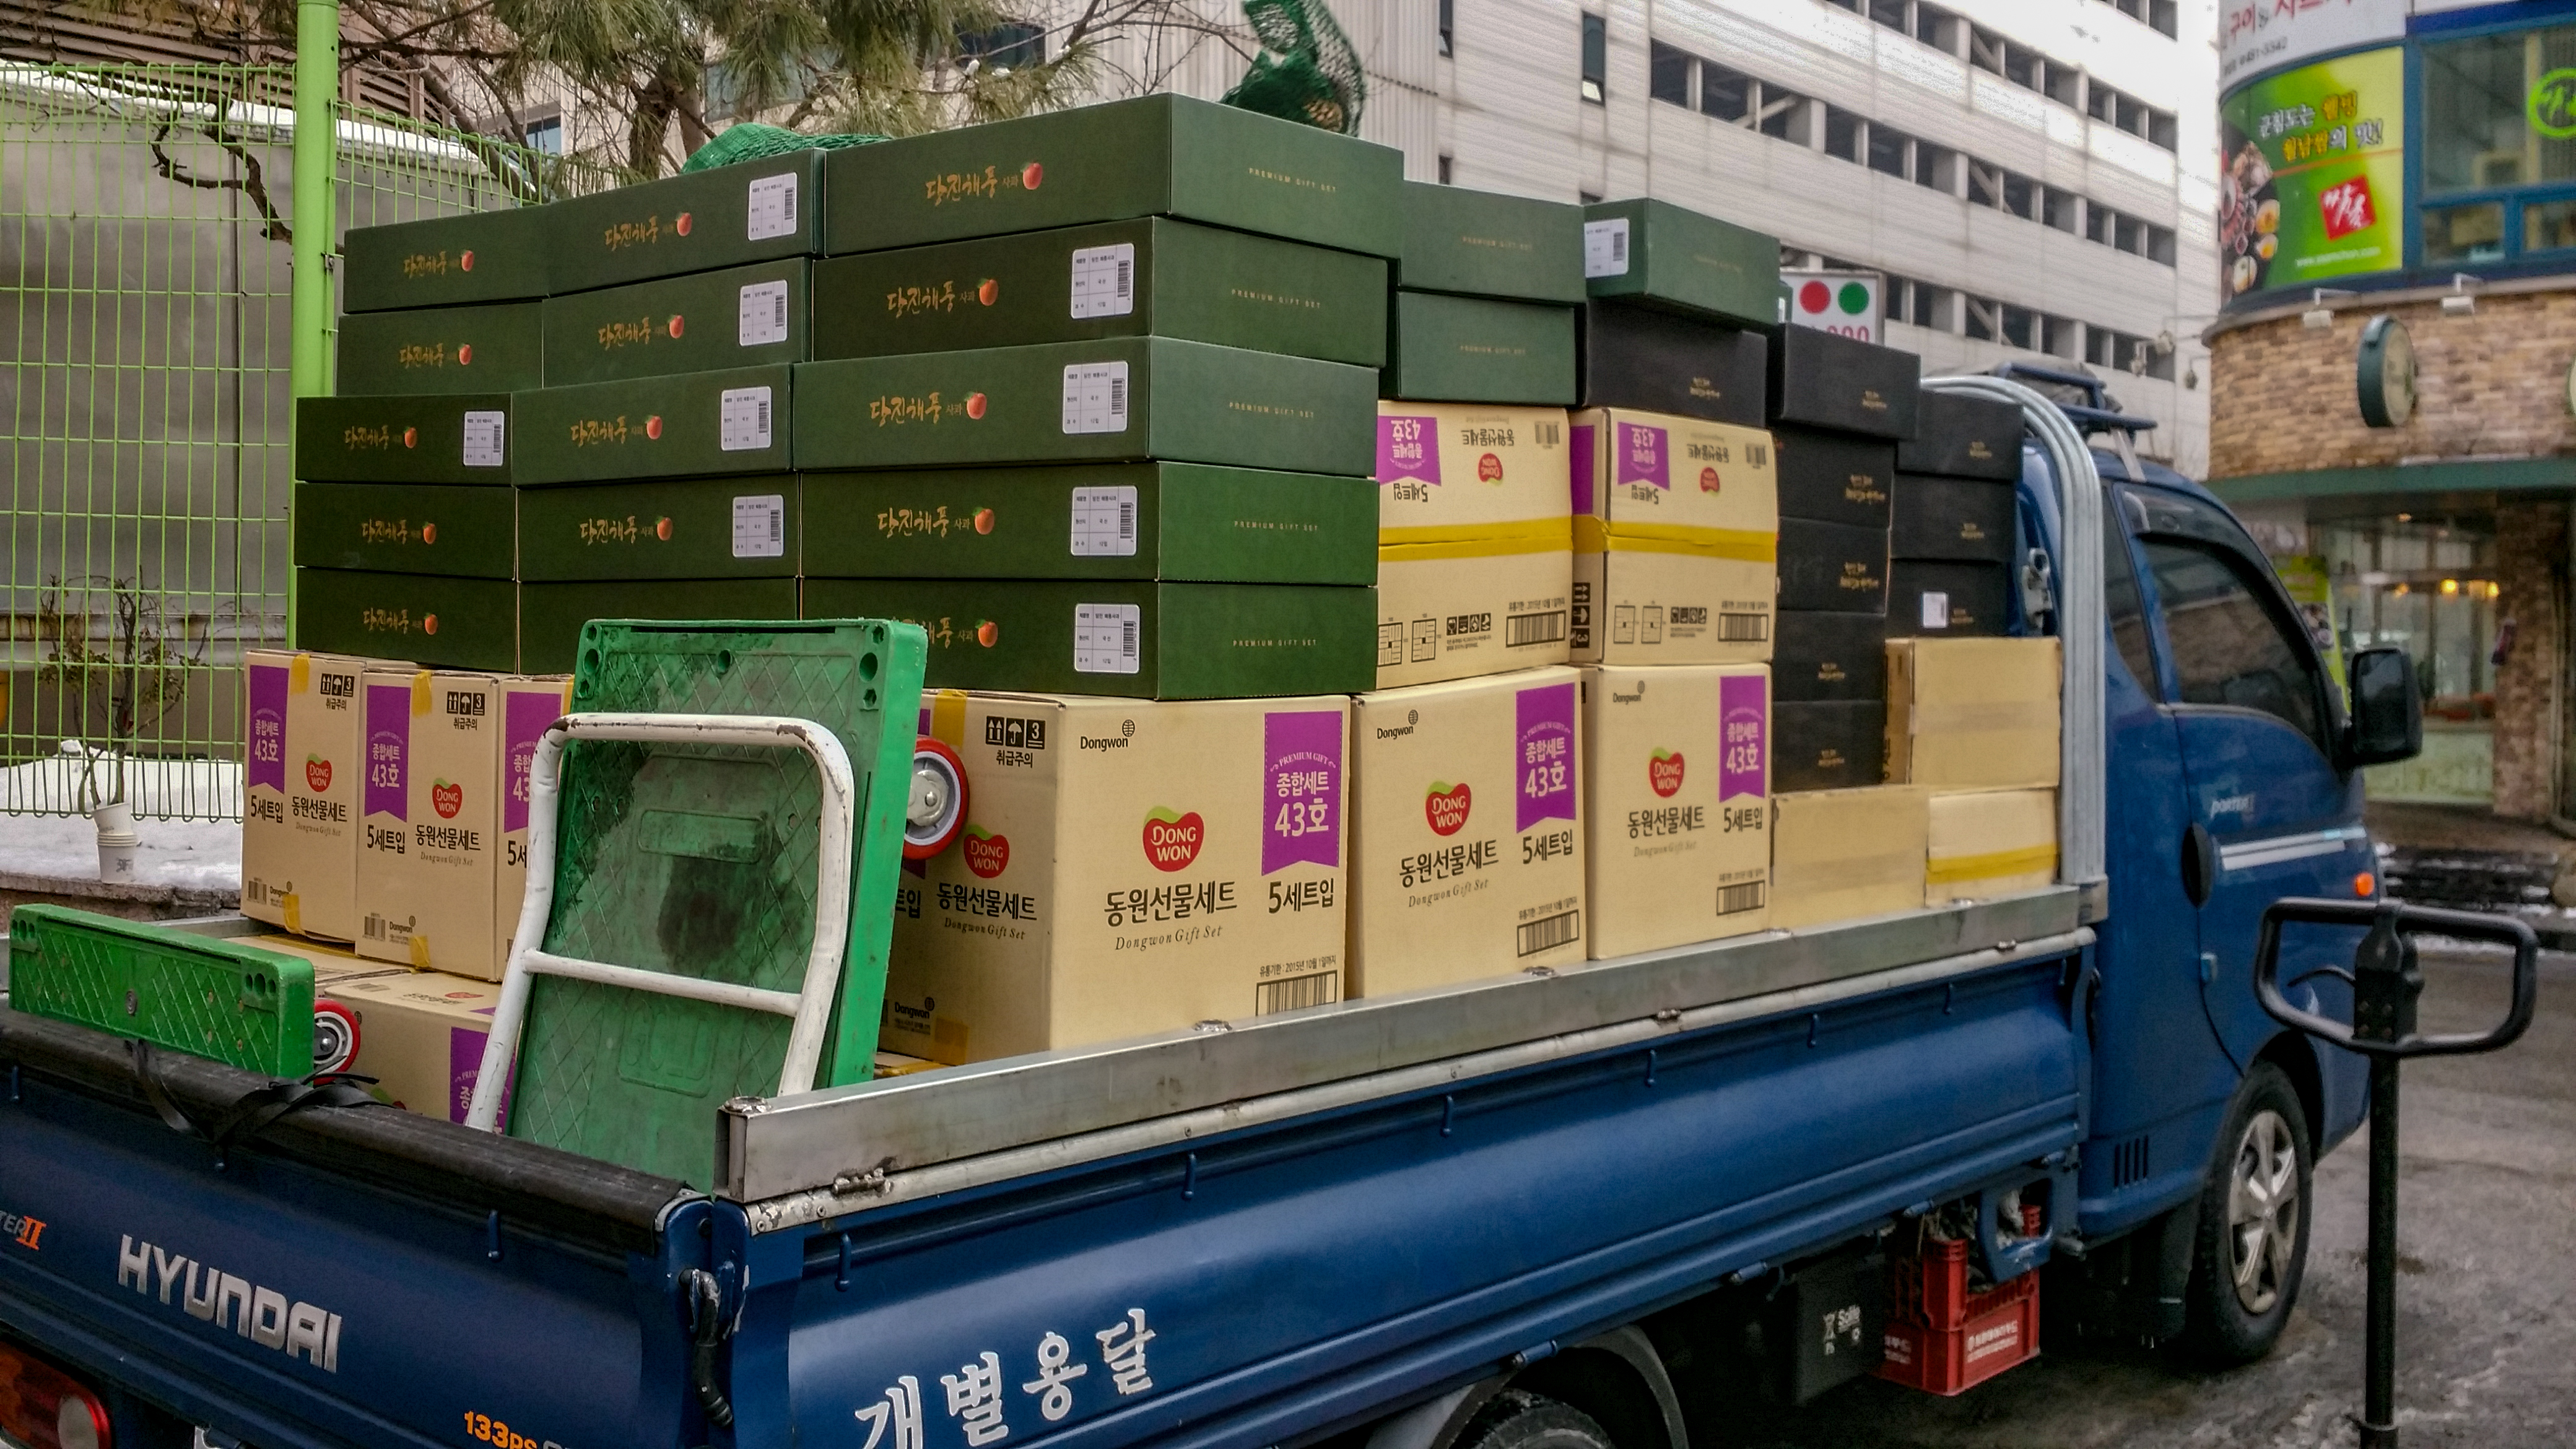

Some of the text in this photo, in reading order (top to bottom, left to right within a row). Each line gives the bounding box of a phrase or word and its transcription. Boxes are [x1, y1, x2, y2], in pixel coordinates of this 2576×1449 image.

[926, 167, 997, 206] 당진해풍
[1249, 168, 1338, 194] PREMIUM GIFT SET
[605, 216, 658, 248] 당진해풍
[887, 281, 955, 319] 당진해풍
[1232, 288, 1321, 309] PREMIUM GIFT SET
[598, 317, 650, 348] 당진해풍
[870, 391, 942, 427] 당진해풍
[1229, 401, 1315, 418] PREMIUM GIFT SET
[570, 416, 627, 448] 당진해풍
[1391, 419, 1421, 441] 43호
[1393, 483, 1428, 502] 5세트입
[580, 516, 637, 546] 당진해풍
[879, 507, 948, 539] 당진해풍
[1234, 520, 1319, 533] PREMIUM GIFT SET
[1233, 638, 1318, 648] PREMIUM GIFT SET
[326, 698, 347, 711] 취급주의
[1613, 692, 1641, 705] Dongwon
[255, 720, 279, 736] 종합세트
[453, 718, 477, 731] 취급주의
[1377, 726, 1414, 740] Dongwon
[255, 739, 279, 762] 43호
[373, 744, 400, 761] 종합세트
[1080, 736, 1128, 752] Dongwon
[1525, 737, 1566, 764] 종합세트
[996, 750, 1033, 768] 취급주의
[1279, 752, 1329, 767] PREMIUM GIFT
[1726, 742, 1759, 774] 43호
[310, 765, 329, 777] DONG
[372, 764, 399, 788] 43호
[1525, 760, 1567, 798] 43호
[1655, 762, 1681, 777] DONG
[311, 777, 327, 787] WON
[1277, 771, 1329, 797] 종합세트
[1657, 777, 1677, 790] WON
[437, 788, 458, 801] DONG
[1431, 796, 1466, 814] DONG
[251, 795, 283, 824] 5세트입
[292, 796, 347, 822] 동원선물세트
[439, 803, 456, 812] WON
[1275, 798, 1329, 837] 43호
[1436, 811, 1463, 828] WON
[1628, 806, 1705, 838] 동원선물세트
[1724, 806, 1762, 833] 5세트입
[367, 824, 405, 854] 5세트입
[416, 824, 481, 851] 동원선물세트
[1151, 825, 1196, 845] DONG
[421, 851, 447, 864] Dongwon
[970, 840, 1003, 858] DONG
[1157, 845, 1191, 862] WON
[1523, 829, 1573, 864] 5세트입
[974, 858, 999, 871] WON
[1399, 839, 1499, 888] 동원선물세트
[936, 882, 1037, 921] 동원선물세트
[1104, 881, 1238, 927] 동원선물세트
[1269, 877, 1334, 914] 5세트입
[1409, 879, 1489, 908] Dongwon Gift Set
[389, 921, 412, 934] Dongwon
[945, 917, 1025, 940] Dongwon Gift Set
[1115, 925, 1223, 952] Dongwon Gift Set
[1260, 964, 1282, 978] 유통기한
[1285, 960, 1304, 973] 2015년
[1306, 958, 1317, 969] 10월
[895, 1002, 929, 1019] Dongwon
[118, 1234, 342, 1373] HYUNDAI
